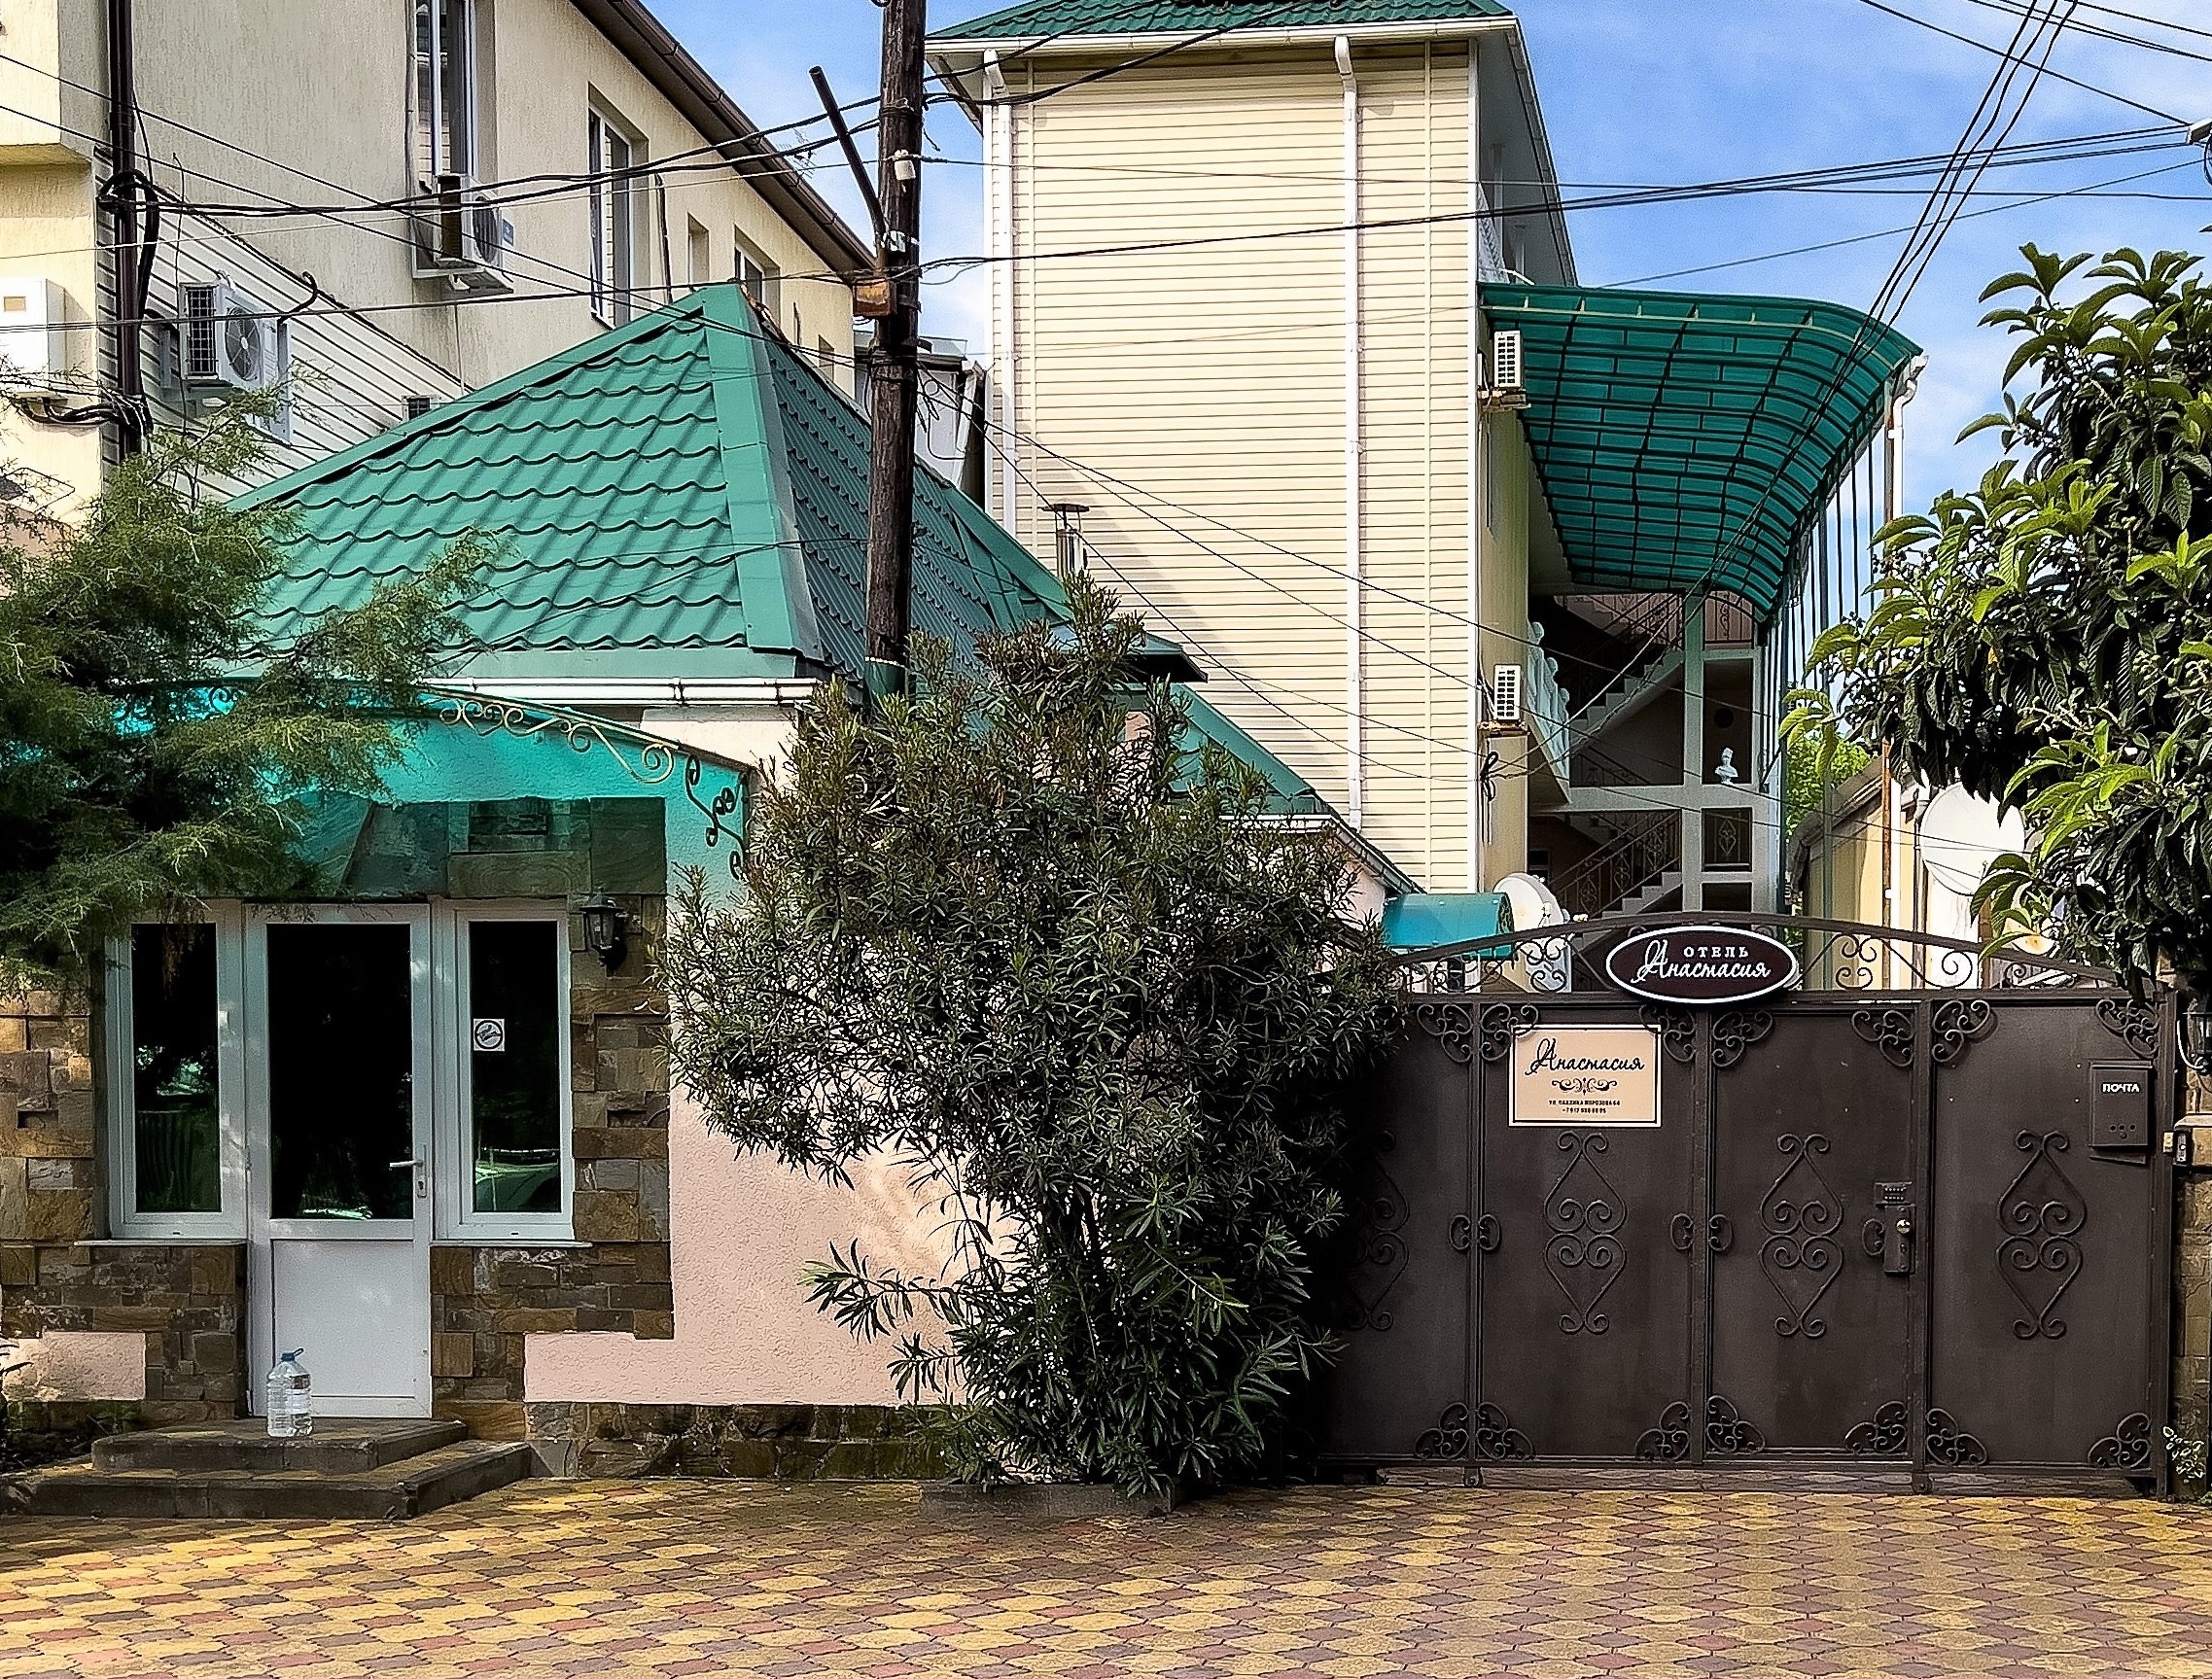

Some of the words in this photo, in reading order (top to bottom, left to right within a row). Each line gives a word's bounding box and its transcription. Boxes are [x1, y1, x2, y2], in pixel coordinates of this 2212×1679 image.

[1630, 939, 1772, 984] Анастасия
[1683, 946, 1749, 959] ОТЕЛЬ
[1524, 1037, 1645, 1076] Анастасия
[2102, 1083, 2140, 1093] ПОЧТА
